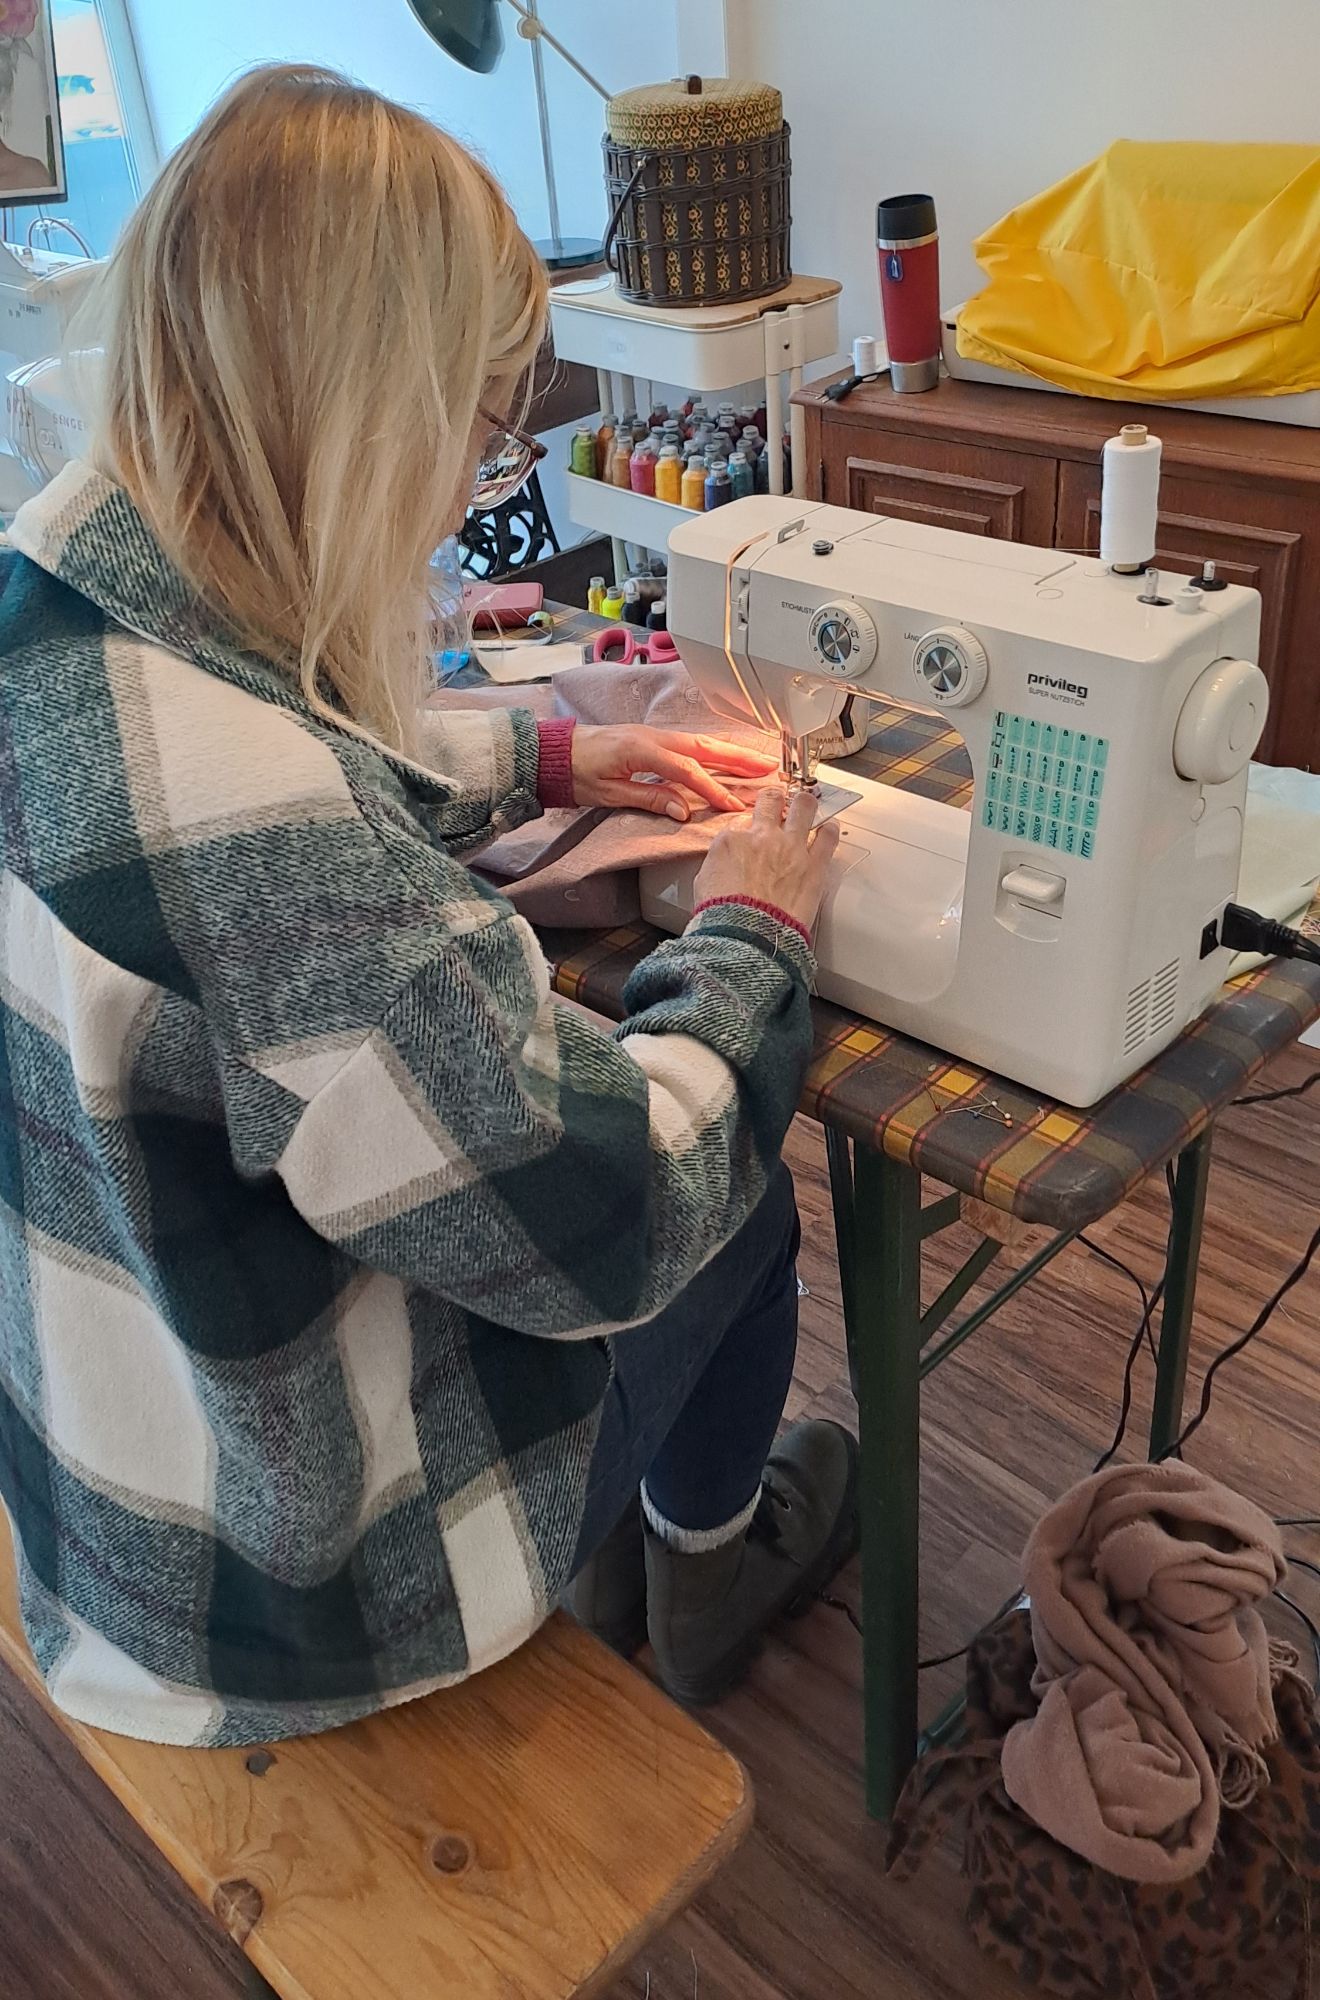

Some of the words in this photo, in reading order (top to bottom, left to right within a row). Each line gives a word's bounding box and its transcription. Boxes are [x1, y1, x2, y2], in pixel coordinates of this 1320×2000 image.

[1027, 673, 1088, 699] privileg
[1028, 686, 1049, 698] SUPER
[1050, 692, 1085, 707] NUTZSTICH
